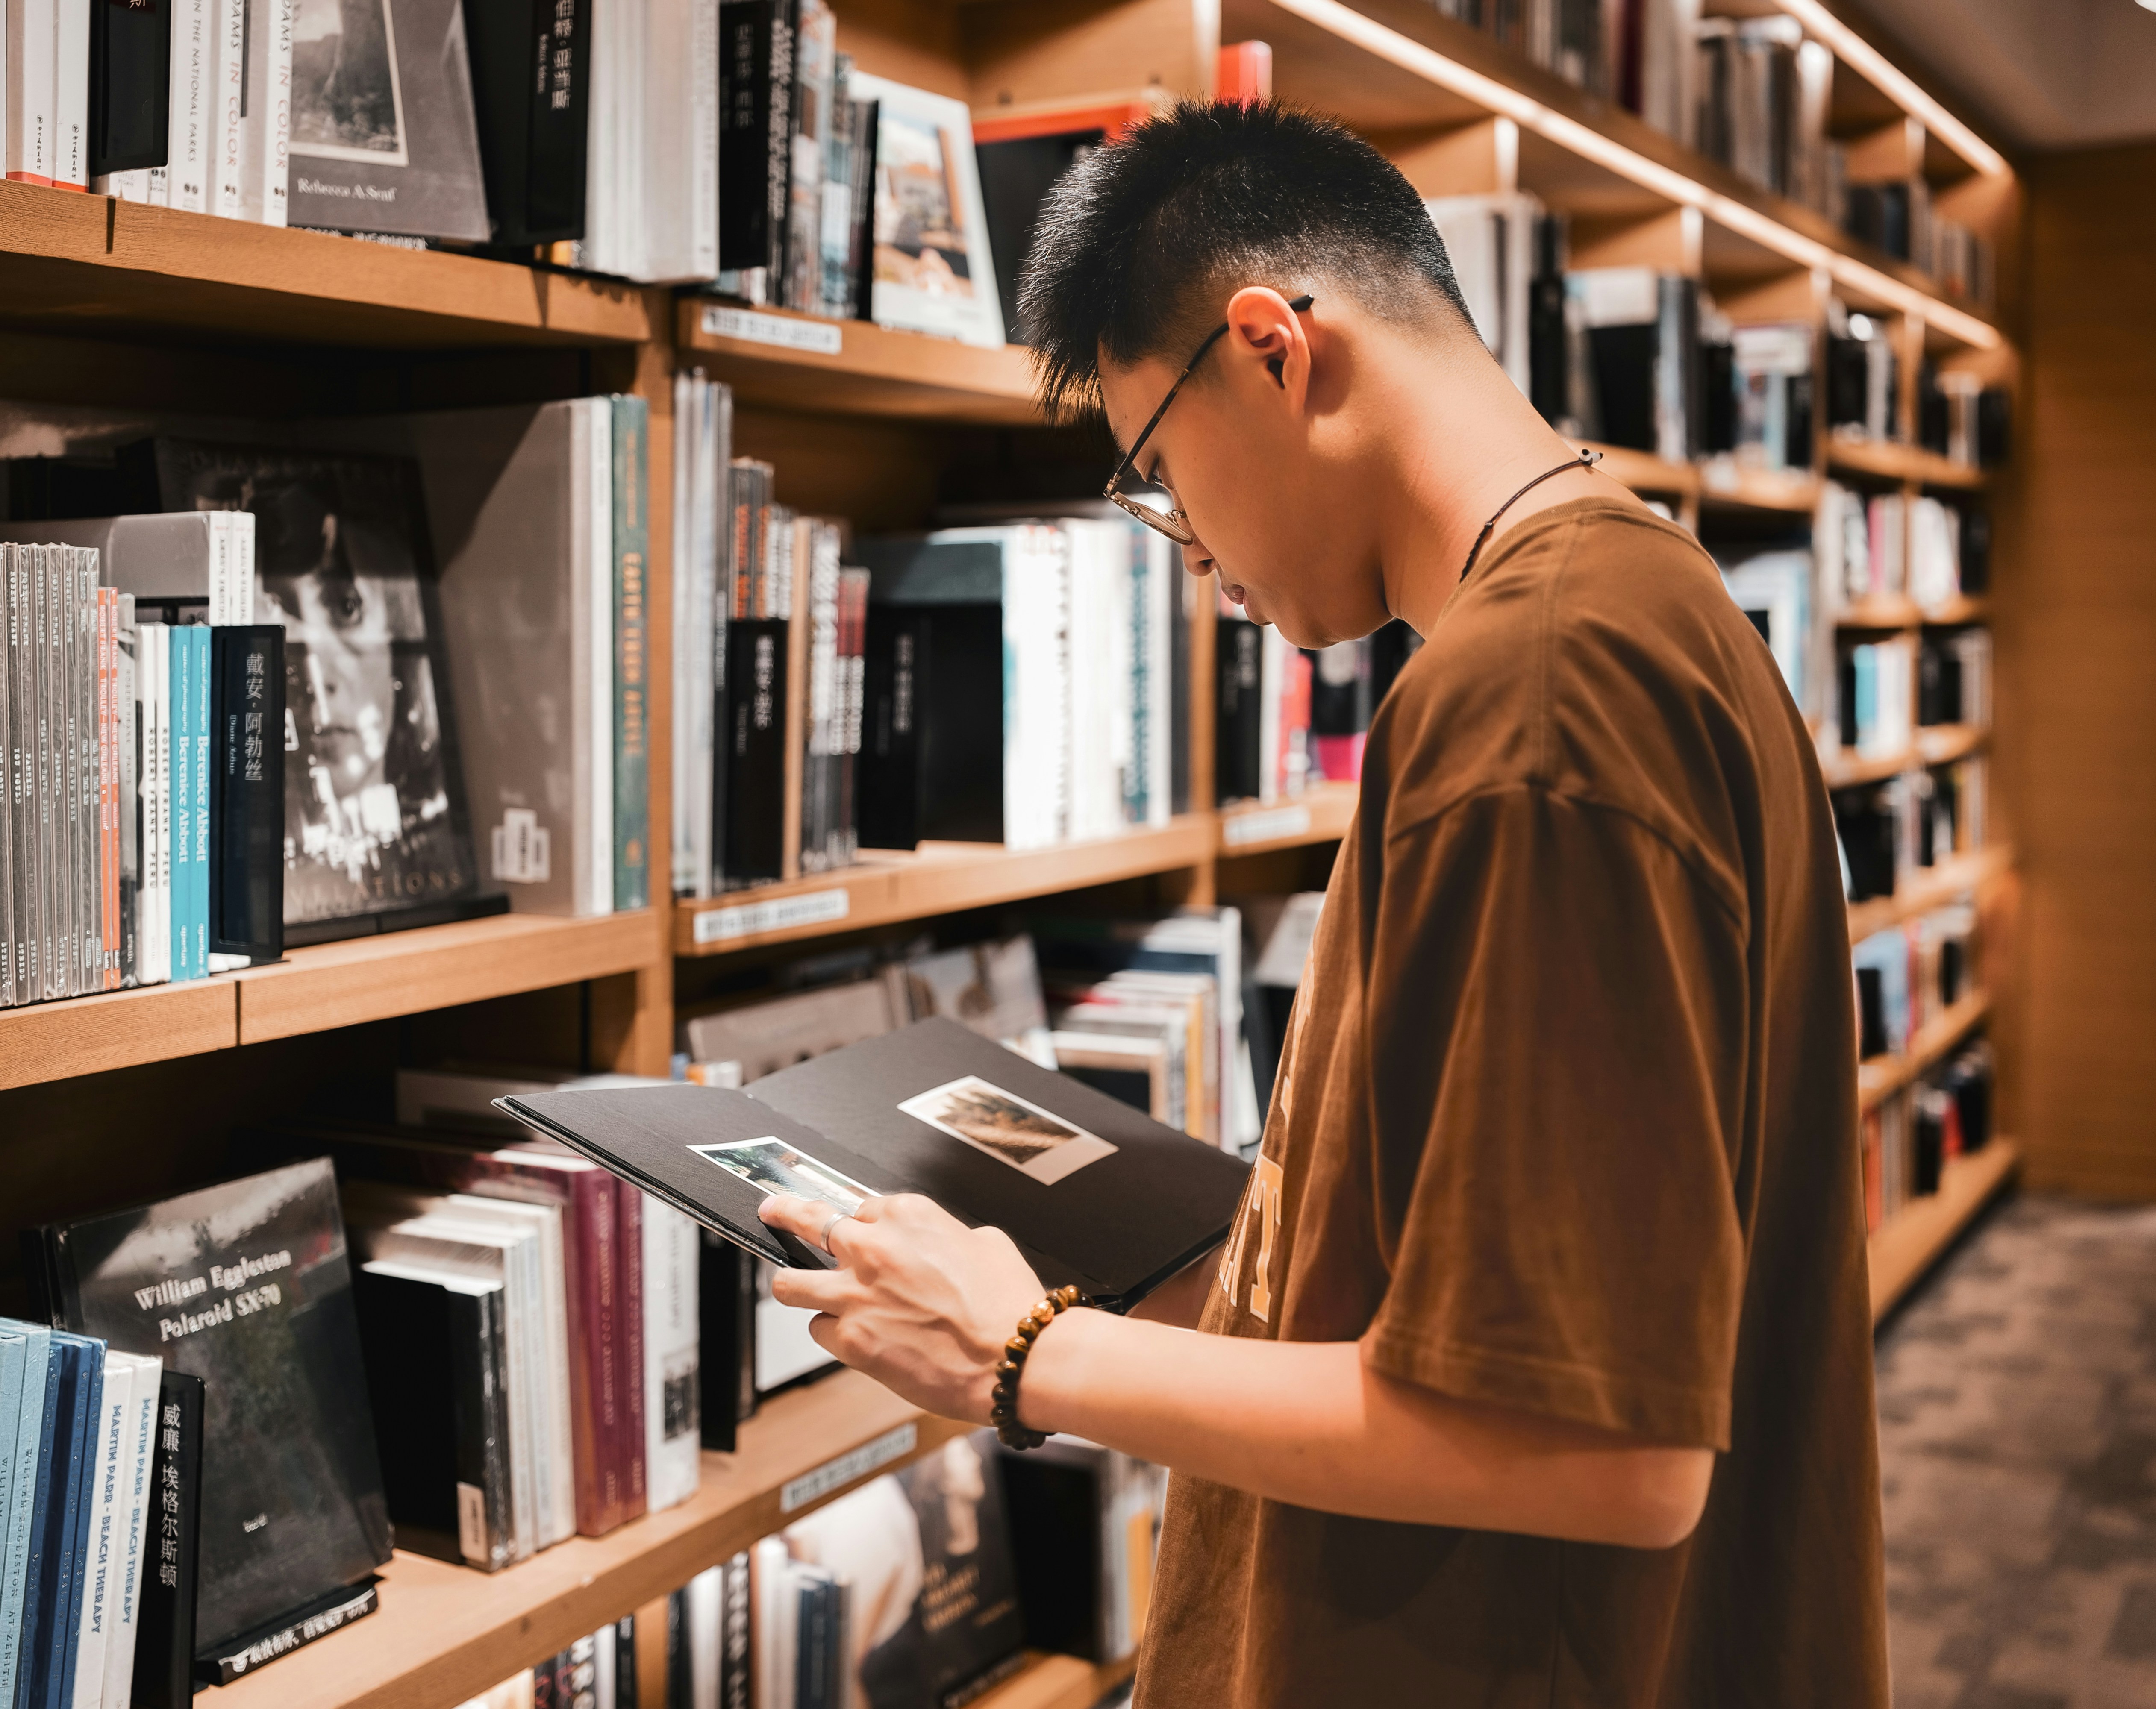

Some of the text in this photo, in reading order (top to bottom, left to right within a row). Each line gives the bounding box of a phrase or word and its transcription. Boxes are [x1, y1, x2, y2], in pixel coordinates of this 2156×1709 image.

[192, 19, 201, 43] THE
[189, 50, 200, 117] NATIONAL
[229, 62, 240, 84] IN
[279, 64, 290, 87] IN
[187, 123, 197, 162] PARKS
[226, 96, 240, 167] COLOR
[276, 99, 289, 169] COLOR
[178, 736, 189, 863] Berenice Abbott
[196, 736, 208, 862] Berenice Abbott
[134, 1250, 291, 1310] William Eggleston
[159, 1283, 281, 1342] Polaroid SX-70
[108, 1405, 122, 1460] MARTIN
[137, 1398, 151, 1454] MARTIN
[21, 1448, 32, 1509] WILLIAM
[104, 1465, 116, 1503] PARR
[133, 1458, 145, 1495] PARR
[160, 1403, 181, 1588] 威廉·埃格尔斯顿
[97, 1516, 111, 1564] BEACH
[128, 1508, 141, 1554] BEACH
[8, 1611, 15, 1625] AT
[91, 1567, 107, 1633] THERAPY
[122, 1559, 136, 1624] THERAPY
[2, 1634, 13, 1686] ZENITH
